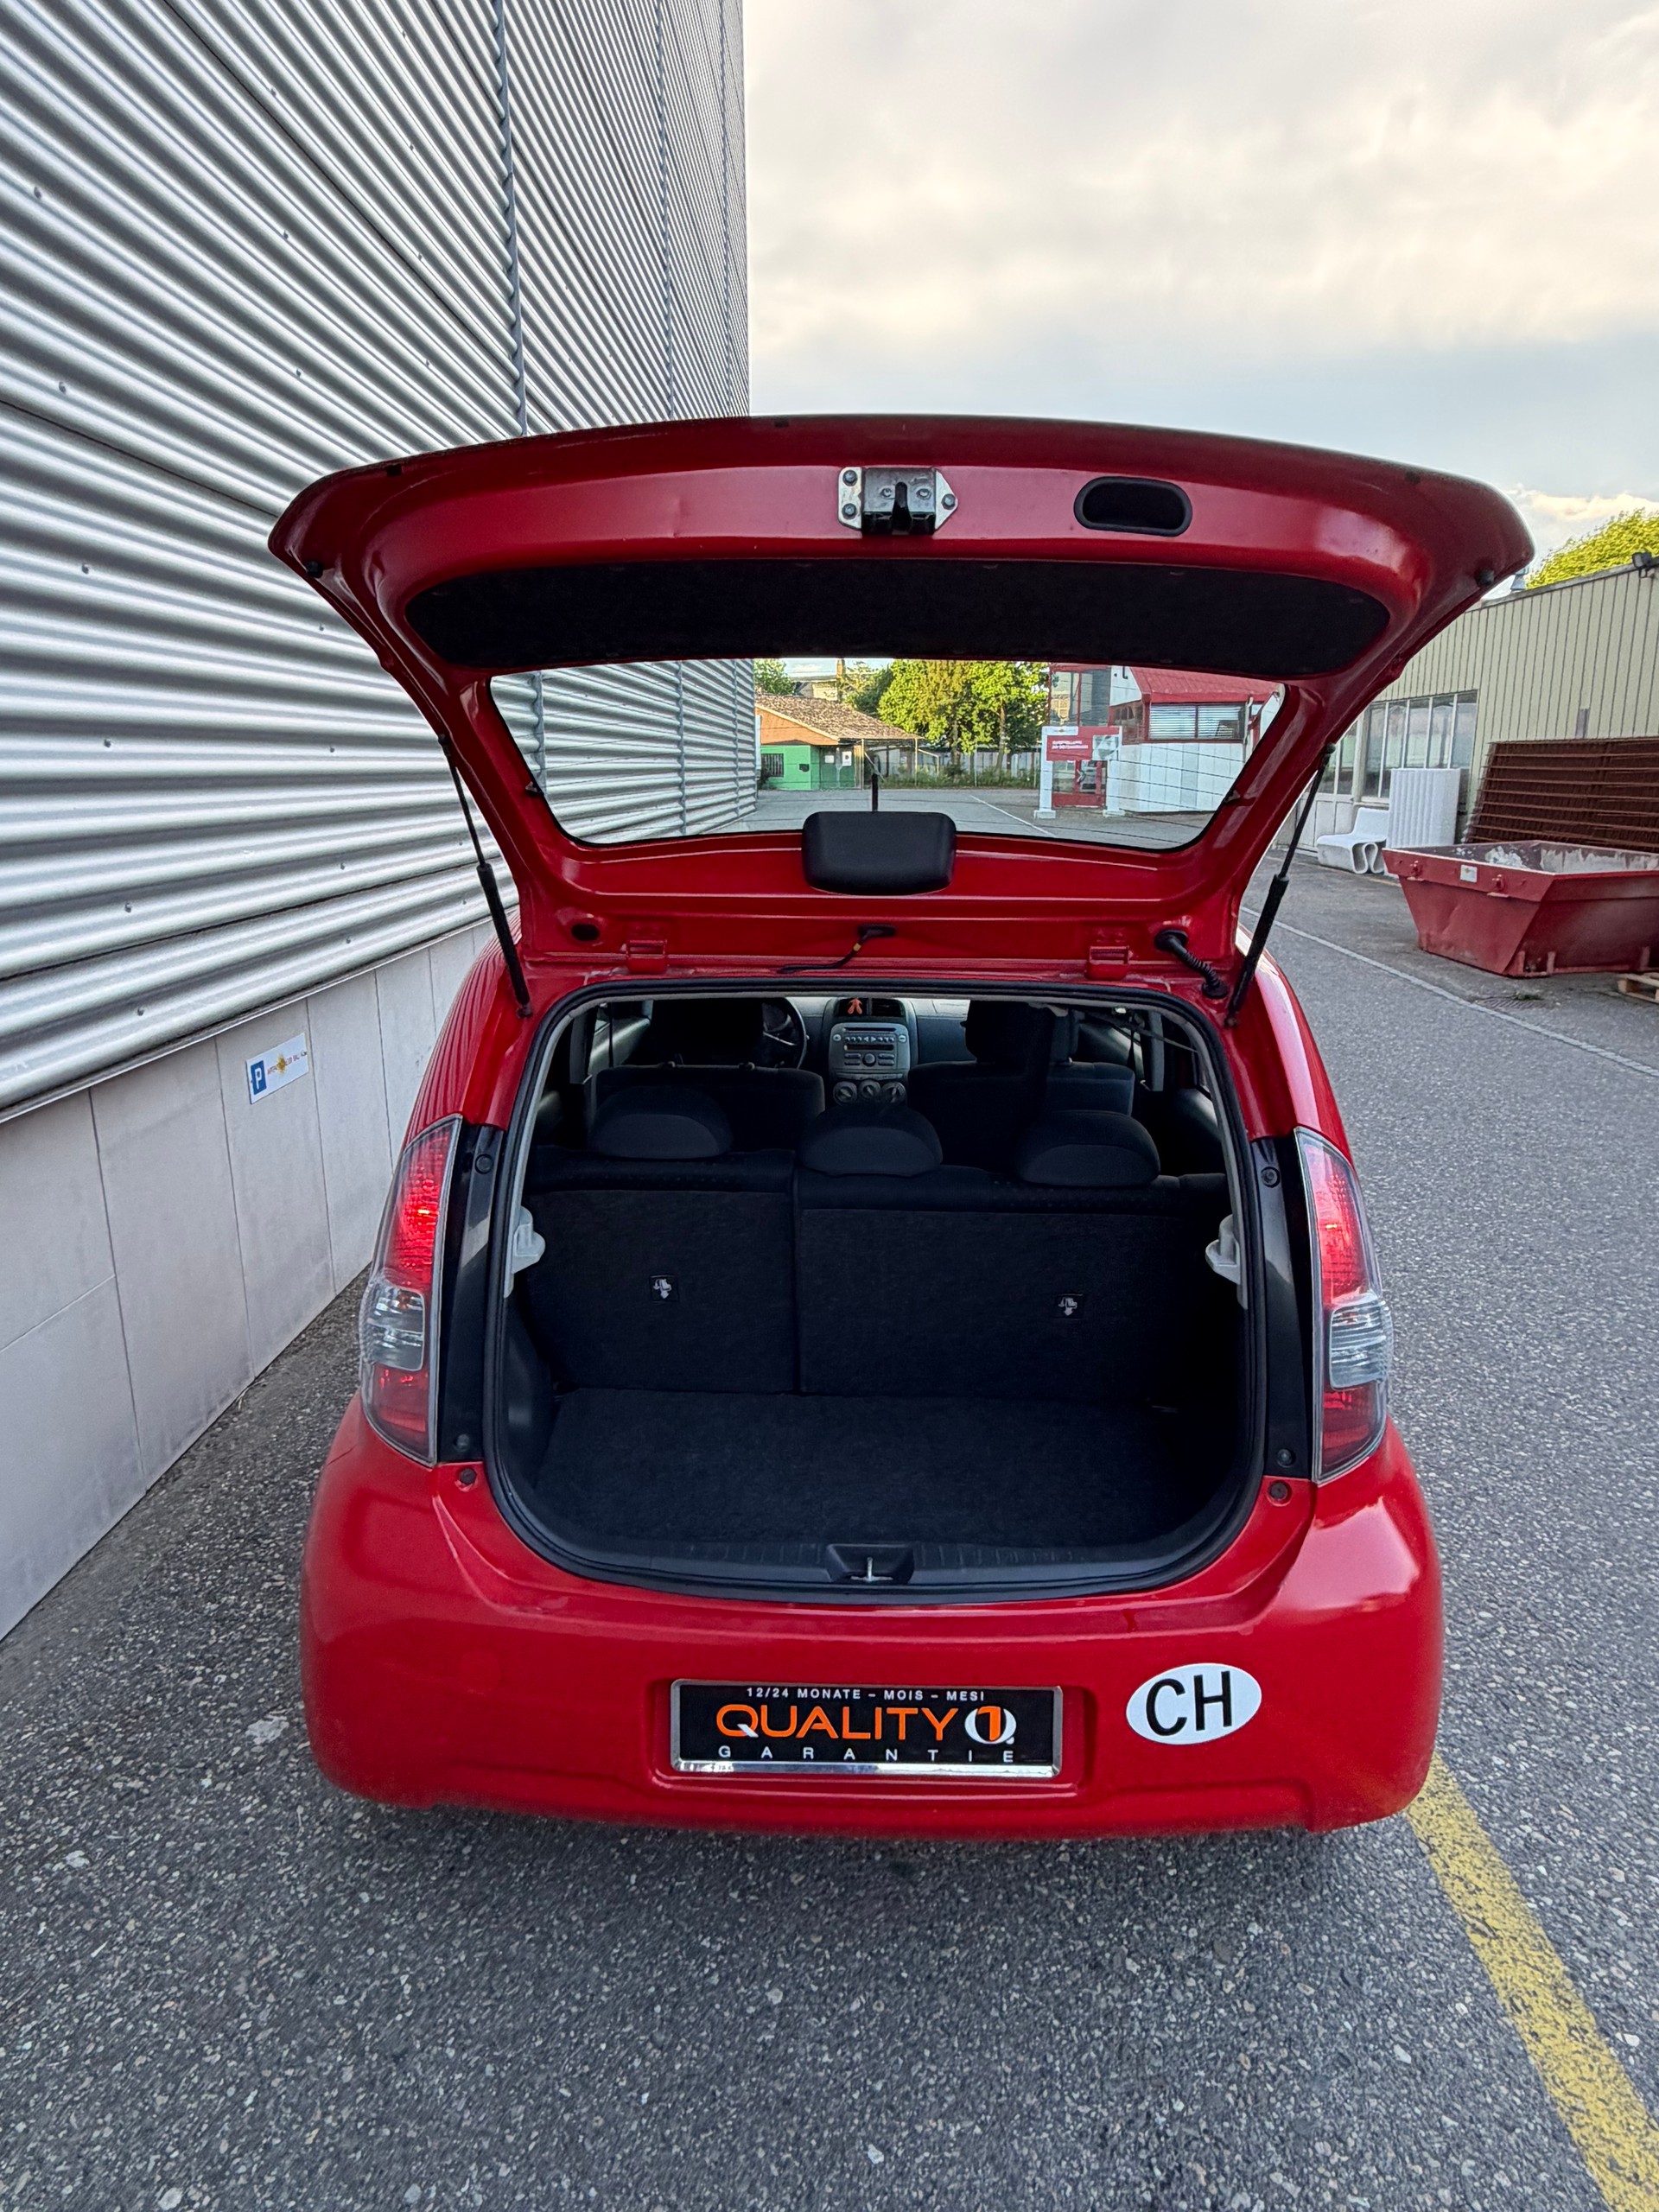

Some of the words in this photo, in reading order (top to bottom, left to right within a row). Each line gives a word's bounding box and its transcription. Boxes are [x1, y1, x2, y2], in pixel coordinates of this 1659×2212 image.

[255, 1068, 263, 1090] P
[747, 1688, 789, 1698] 12/24
[797, 1688, 861, 1700] MONATE
[883, 1689, 924, 1700] MOIS
[946, 1691, 984, 1701] MESI
[1146, 1670, 1232, 1736] CH
[716, 1704, 958, 1741] QUALITY
[718, 1745, 1014, 1763] GARANTIE
